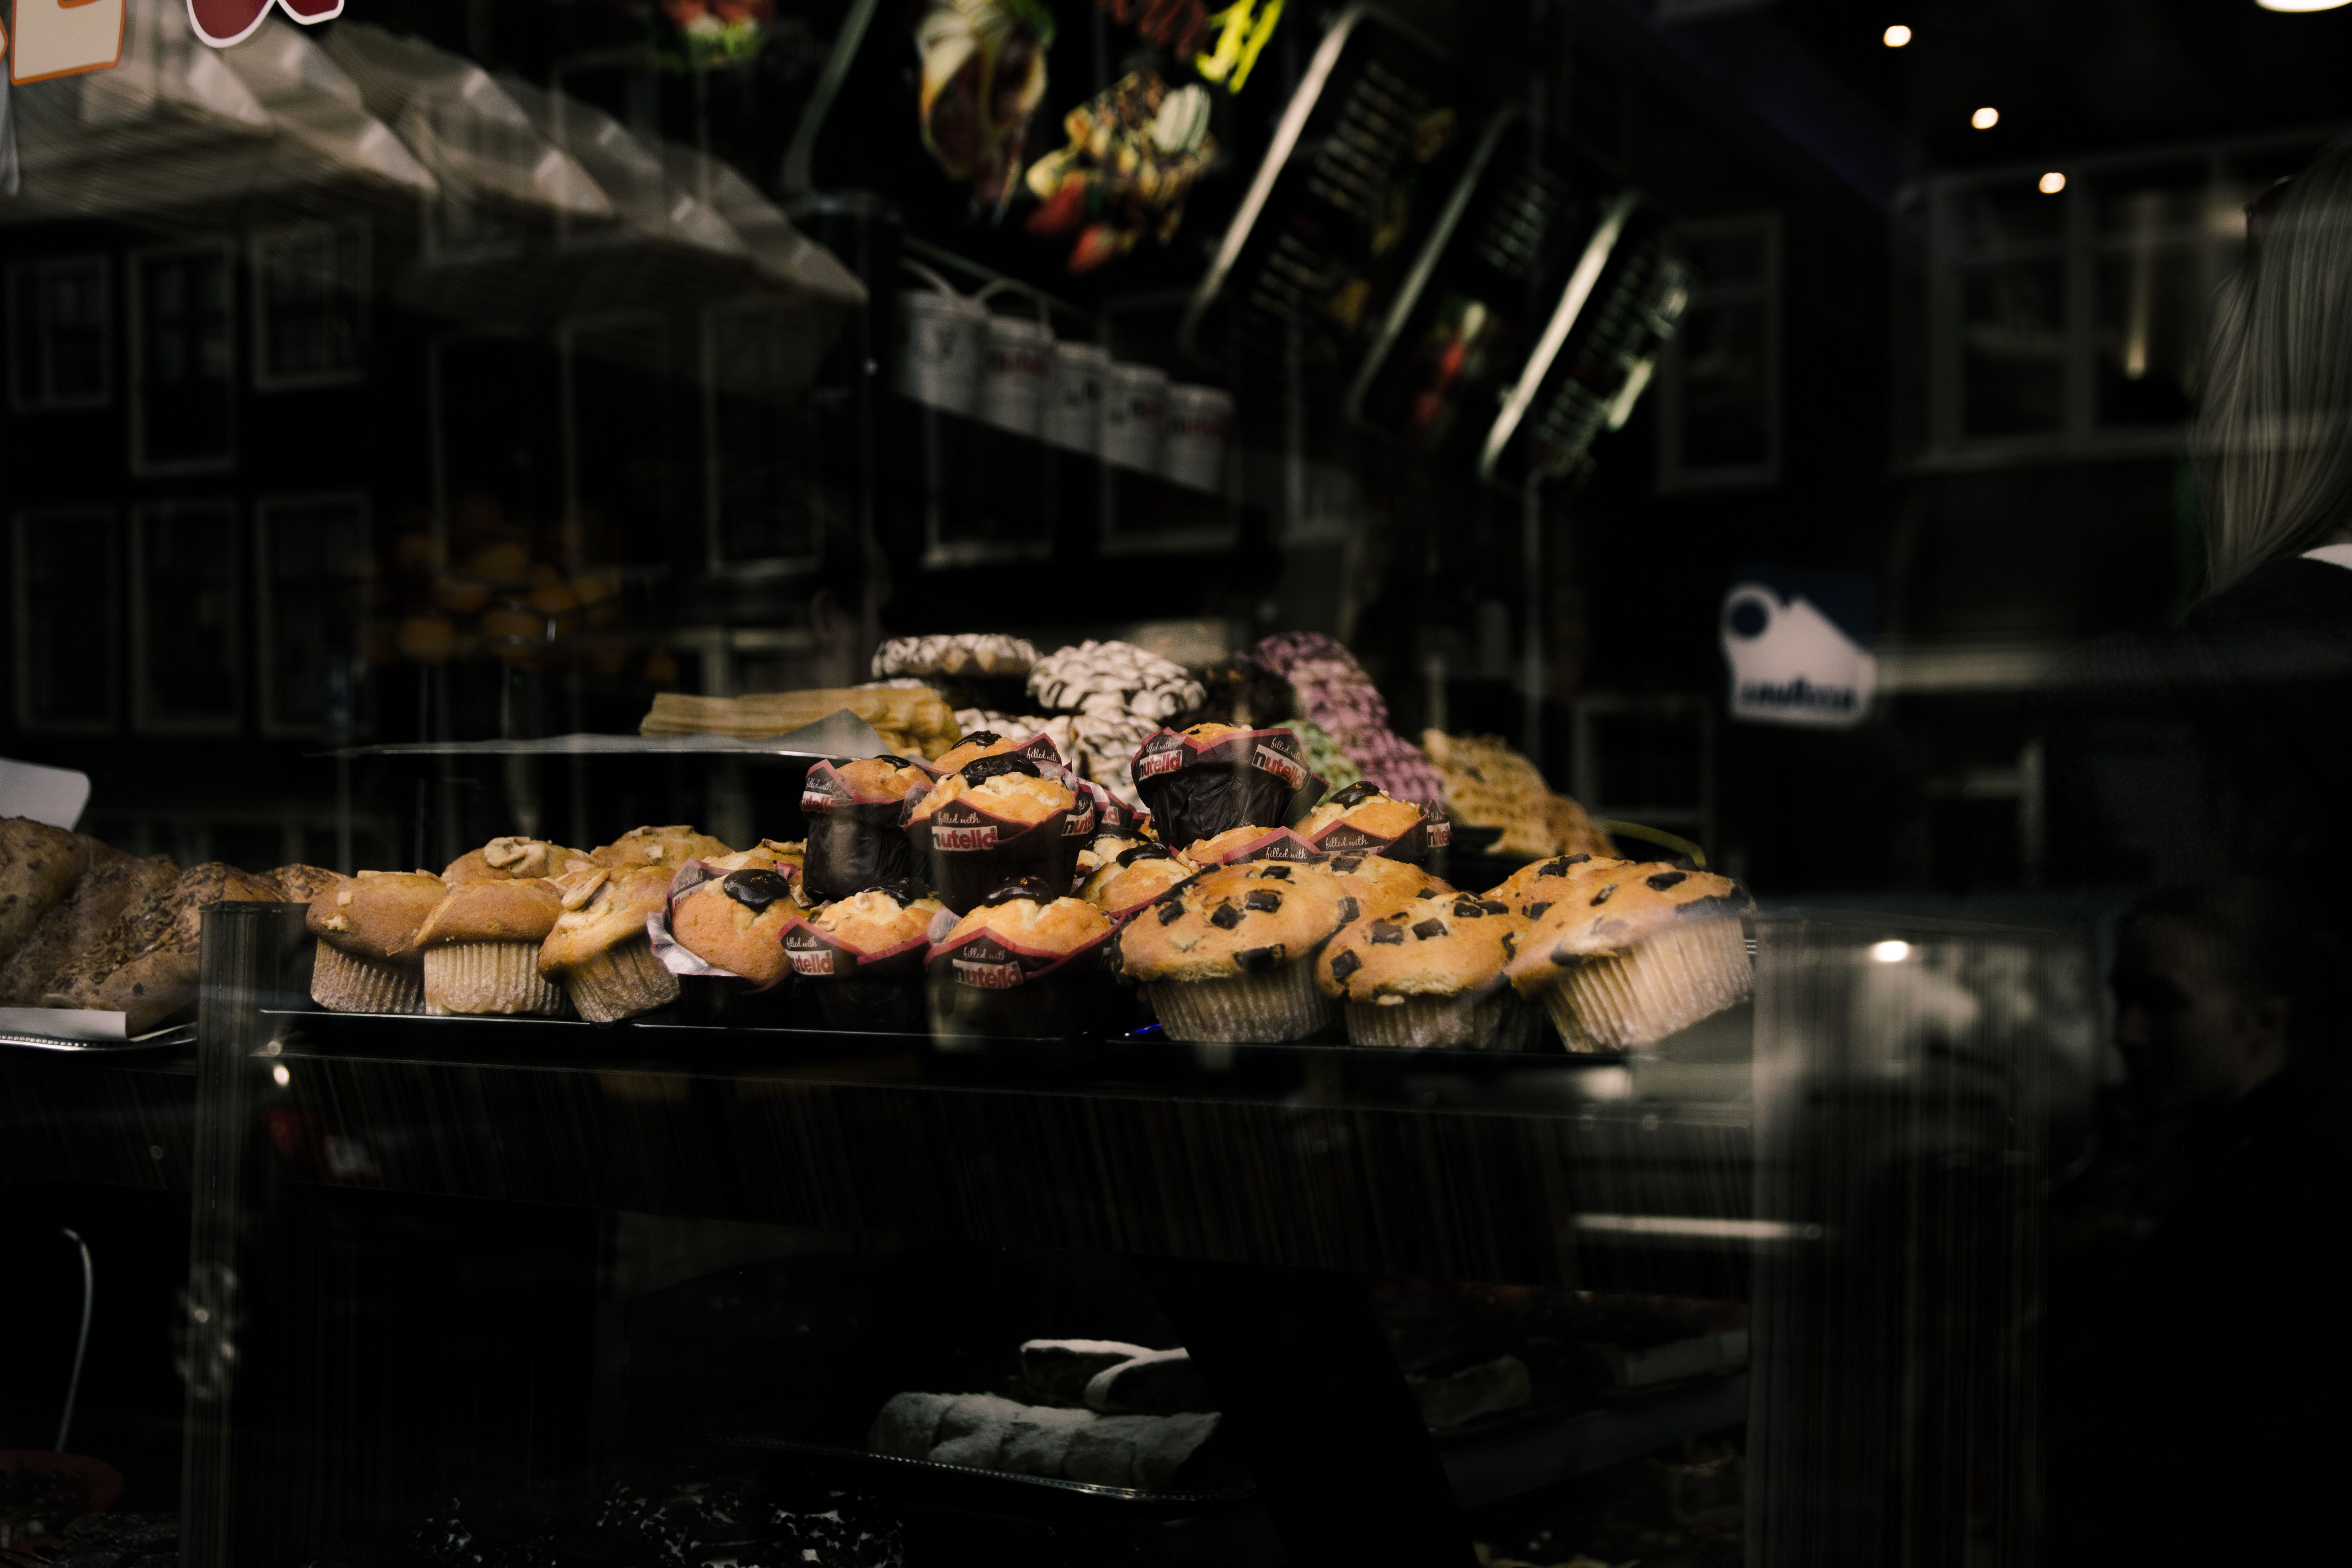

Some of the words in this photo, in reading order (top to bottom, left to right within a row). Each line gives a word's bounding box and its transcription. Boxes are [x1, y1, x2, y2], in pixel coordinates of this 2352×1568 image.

[1271, 737, 1290, 754] filled
[1027, 747, 1046, 760] filled
[1047, 752, 1058, 762] with
[1139, 753, 1181, 777] nutella
[1253, 751, 1303, 790] nutella
[938, 812, 959, 825] filled
[960, 812, 980, 824] with
[932, 829, 996, 848] nutella
[1326, 836, 1348, 850] filled
[1348, 834, 1368, 846] with
[1266, 847, 1289, 859] filled
[1290, 847, 1308, 859] with
[786, 936, 802, 949] filled
[802, 935, 818, 948] with
[963, 946, 987, 960] filled
[791, 953, 833, 972] utella
[953, 967, 1021, 988] nutella
